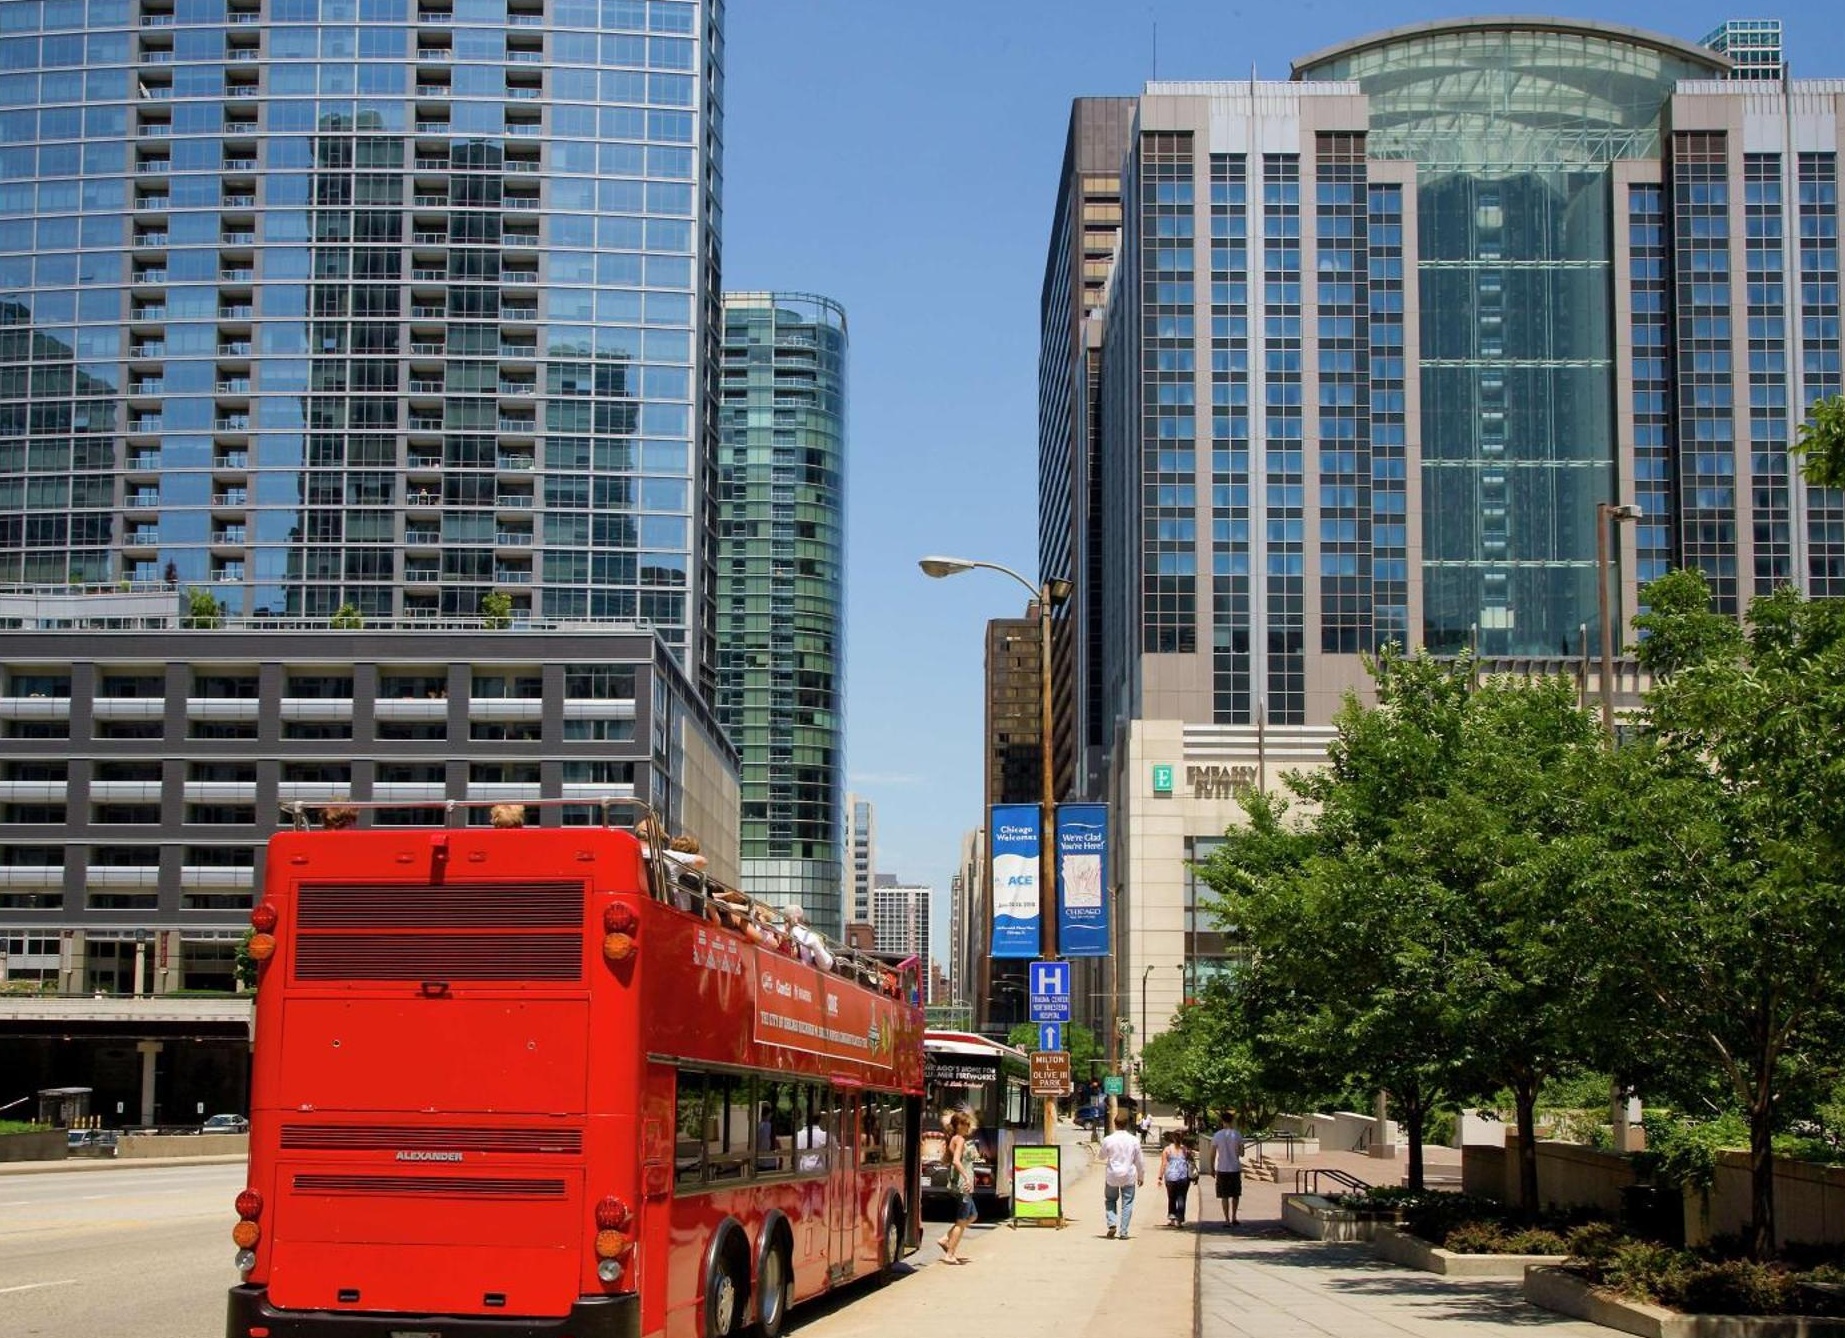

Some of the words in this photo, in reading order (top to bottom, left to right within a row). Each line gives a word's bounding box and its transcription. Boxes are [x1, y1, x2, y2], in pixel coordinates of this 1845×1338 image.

[1186, 766, 1258, 783] EMBASSY
[1000, 826, 1033, 834] Chicago
[996, 833, 1037, 842] Welcomes
[1062, 833, 1083, 842] We're
[1084, 832, 1102, 842] Glad
[1061, 841, 1083, 850] You're
[1083, 840, 1105, 850] Here!
[1008, 875, 1033, 886] ACE
[1038, 968, 1061, 994] H
[1035, 1056, 1064, 1064] MILTON
[955, 1072, 997, 1081] FIREWORKS
[1033, 1071, 1058, 1079] OLIVE
[1060, 1071, 1068, 1079] III
[1039, 1079, 1061, 1087] PARK
[395, 1151, 464, 1162] ALEXANDER
